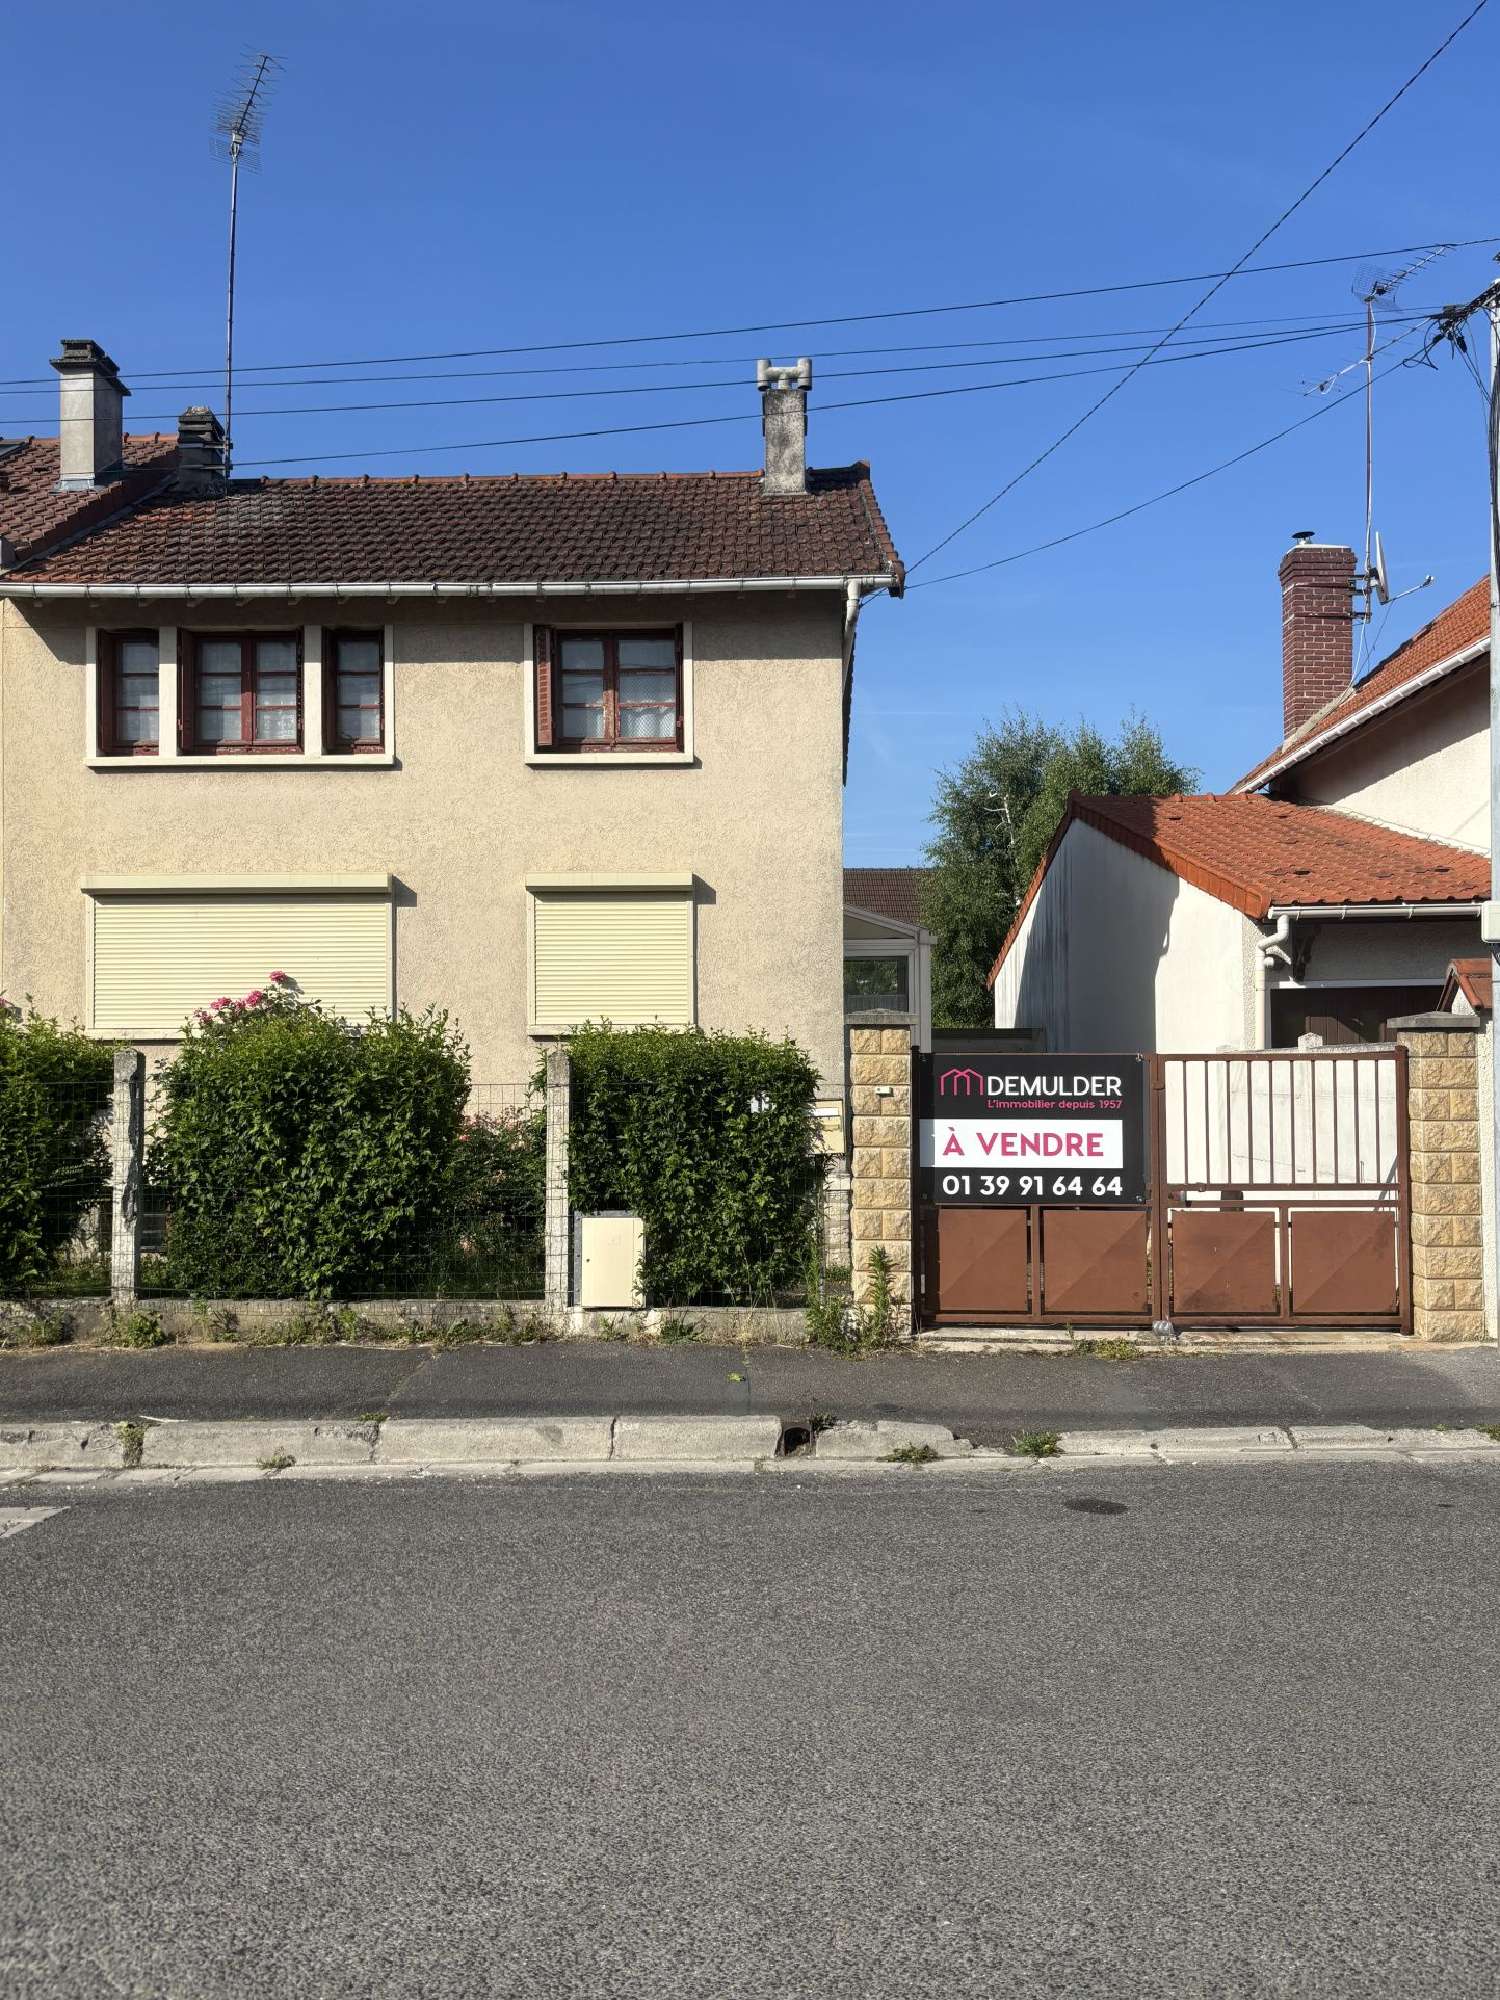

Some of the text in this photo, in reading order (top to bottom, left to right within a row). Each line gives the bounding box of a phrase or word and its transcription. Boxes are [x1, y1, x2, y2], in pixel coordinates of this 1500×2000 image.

[987, 1075, 1123, 1097] DEMULDER
[987, 1099, 1122, 1111] L'immobilier depuis 1957
[942, 1126, 1104, 1157] À VENDRE
[942, 1175, 1123, 1196] 01 39 91 64 64
